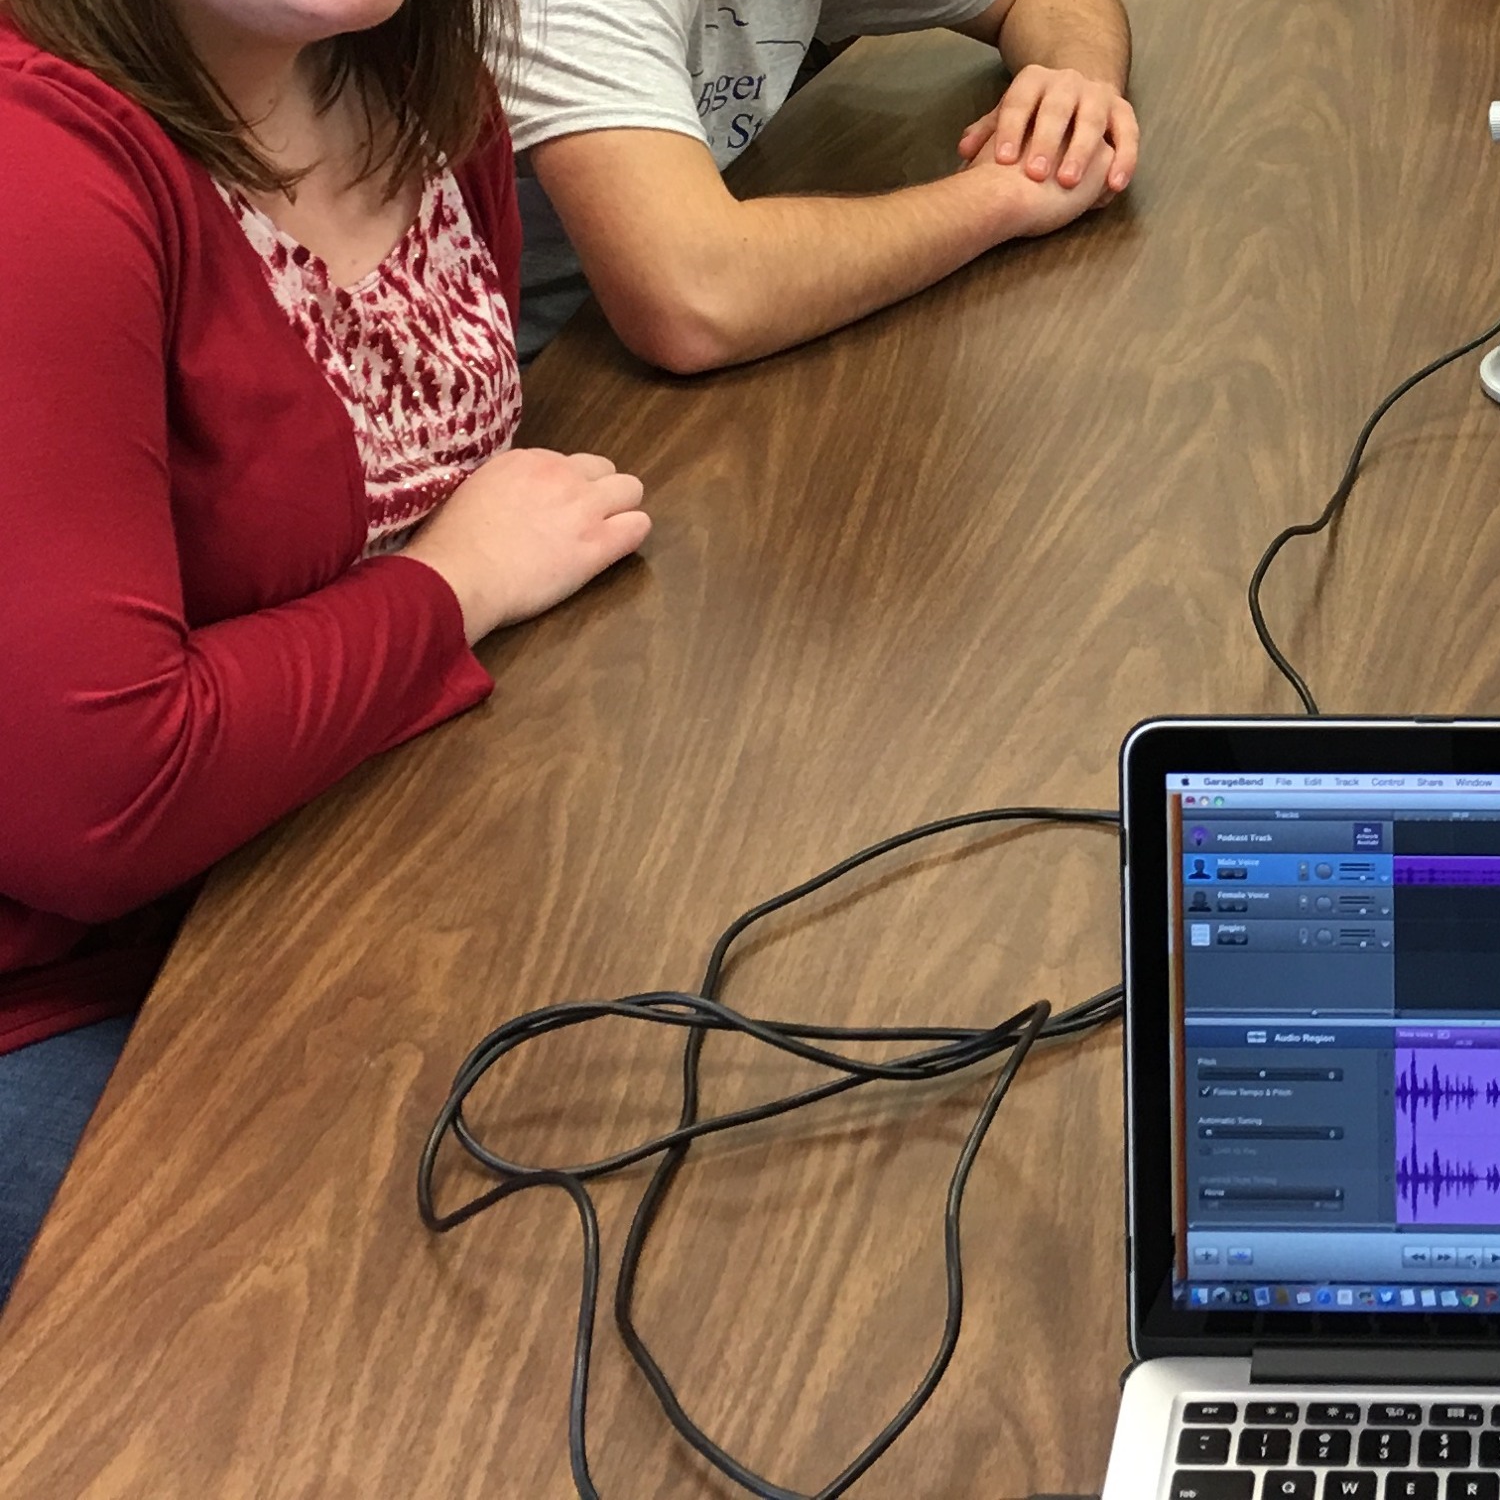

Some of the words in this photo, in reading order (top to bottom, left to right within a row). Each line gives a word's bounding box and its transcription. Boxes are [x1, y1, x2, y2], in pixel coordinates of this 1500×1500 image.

[1203, 777, 1264, 787] GarageBand
[1275, 778, 1292, 786] File
[1304, 778, 1322, 786] Edit
[1334, 778, 1359, 786] Track
[1371, 778, 1405, 787] Control
[1417, 778, 1443, 787] Share
[1455, 778, 1493, 787] Window
[1217, 834, 1248, 842] Podcast
[1250, 834, 1272, 842] Track
[1274, 1034, 1301, 1043] Audio
[1302, 1034, 1335, 1044] Region
[1239, 1089, 1264, 1097] Tempo
[1198, 1117, 1236, 1125] Automatic
[1319, 1447, 1329, 1458] 2
[1379, 1448, 1389, 1459] 3
[1439, 1448, 1449, 1459] 4
[1281, 1481, 1296, 1494] Q
[1341, 1482, 1359, 1495] W
[1406, 1482, 1415, 1495] E
[1467, 1483, 1478, 1496] R
